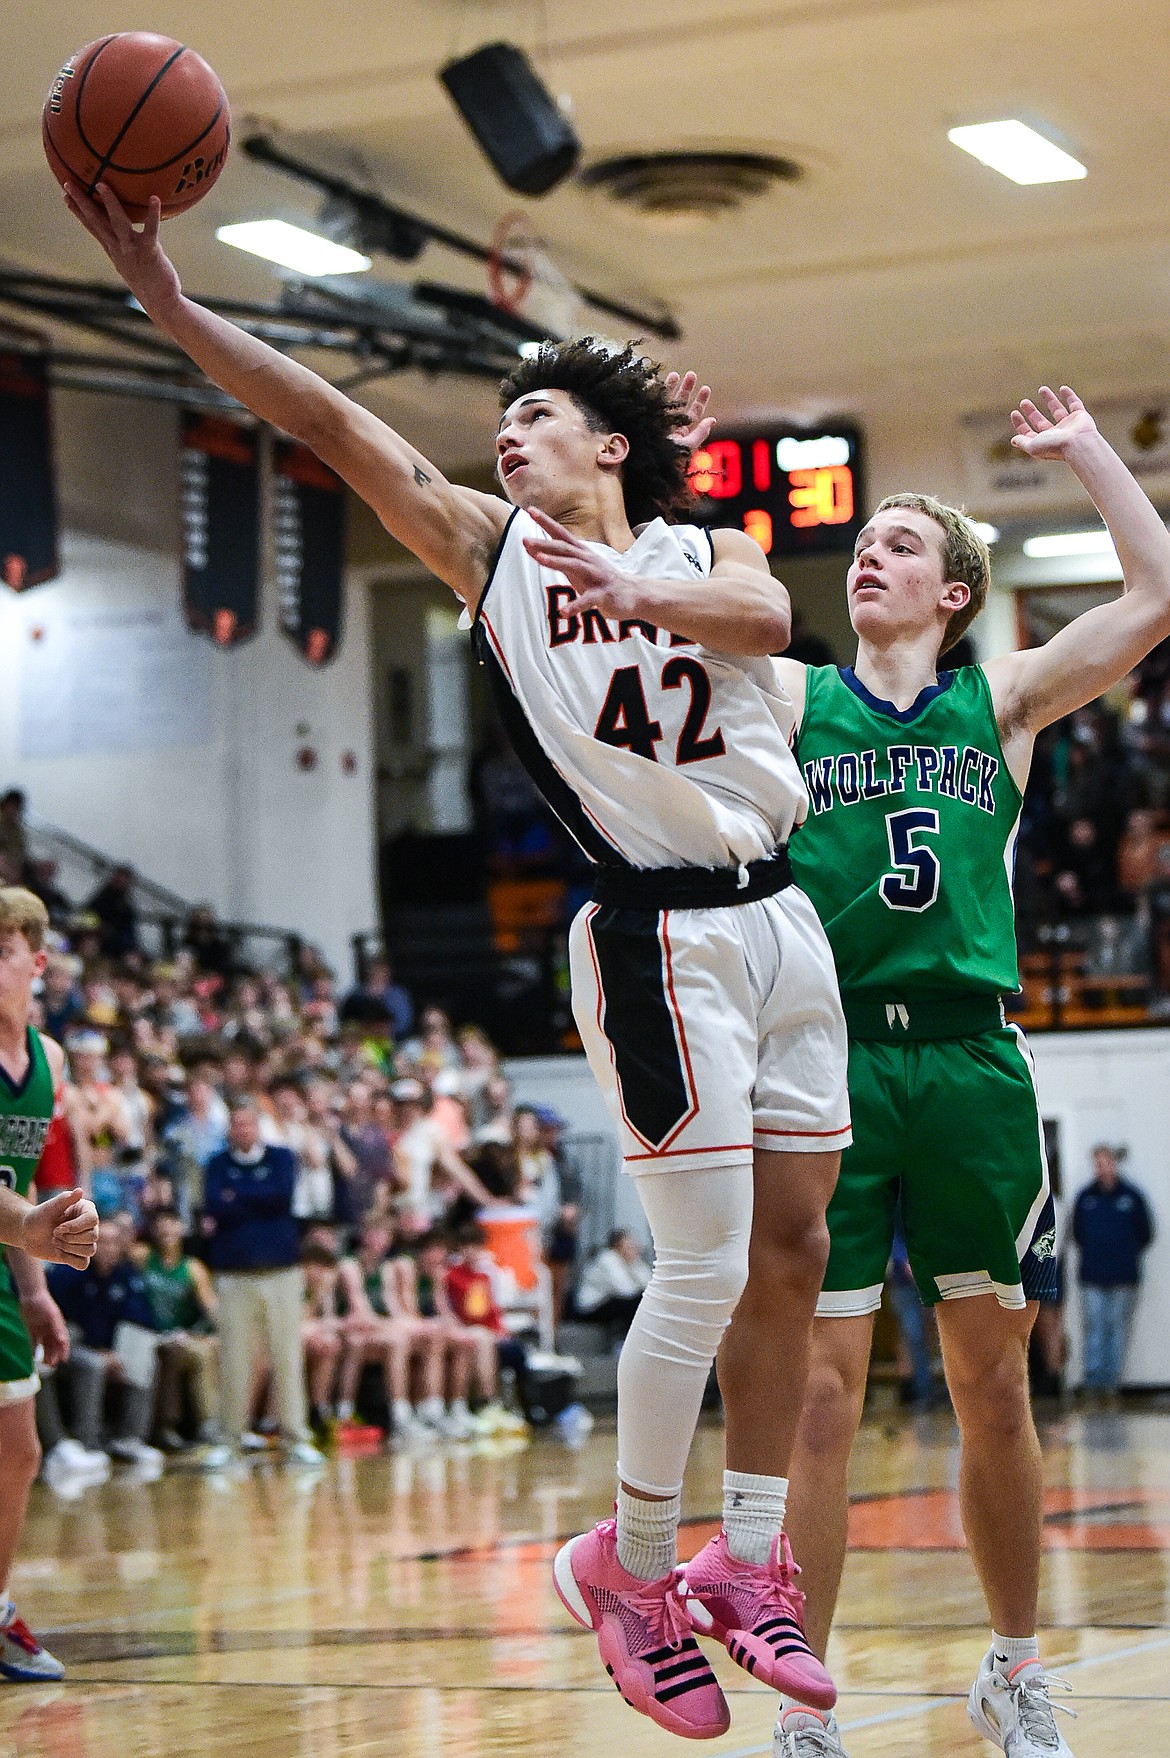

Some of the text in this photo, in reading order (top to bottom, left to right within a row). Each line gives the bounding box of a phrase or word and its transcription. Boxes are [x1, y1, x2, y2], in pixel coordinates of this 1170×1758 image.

[593, 655, 727, 766] 42
[804, 744, 999, 816] WOLFPACK
[878, 806, 941, 914] 5
